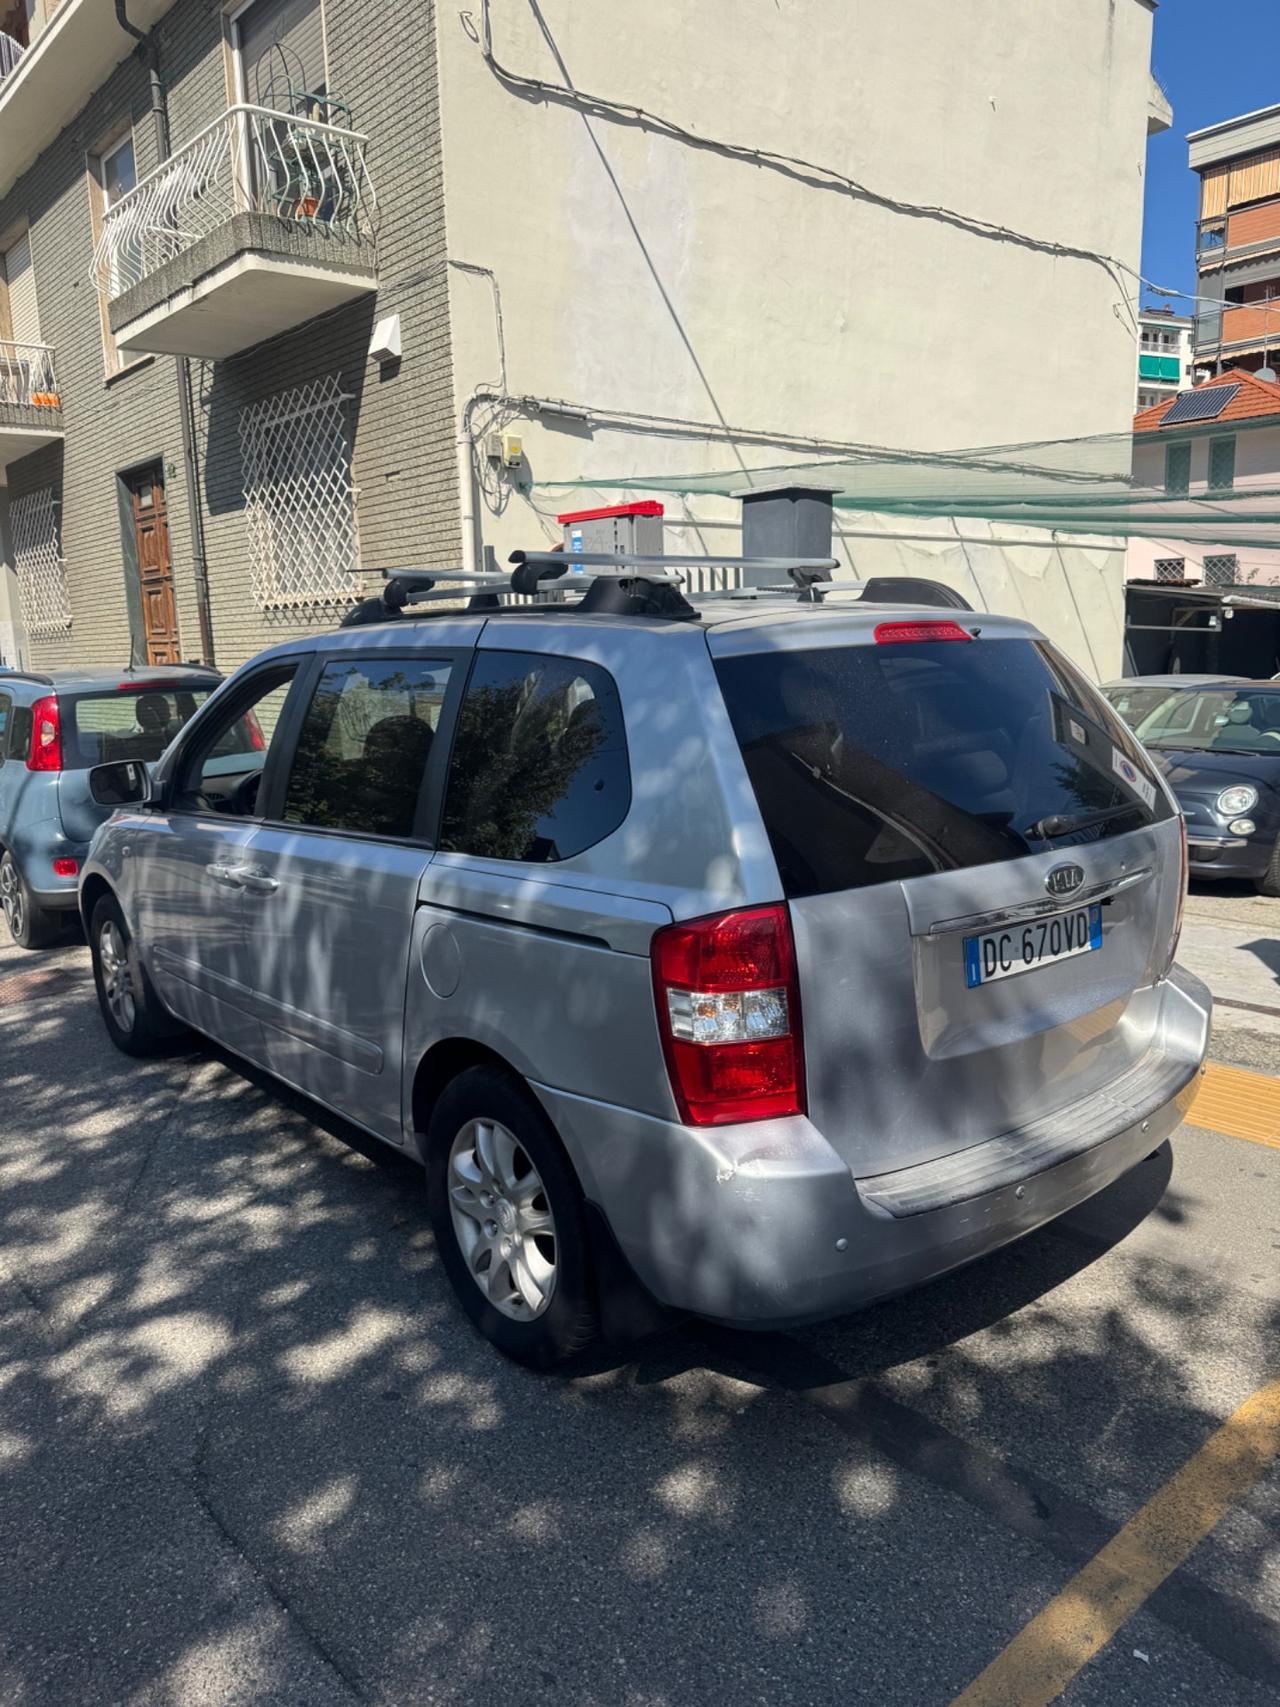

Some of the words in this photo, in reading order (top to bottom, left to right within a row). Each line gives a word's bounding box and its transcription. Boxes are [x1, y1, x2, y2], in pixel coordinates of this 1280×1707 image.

[1052, 868, 1082, 892] KIA
[983, 934, 1012, 978] DC
[1022, 912, 1088, 965] 670VD
